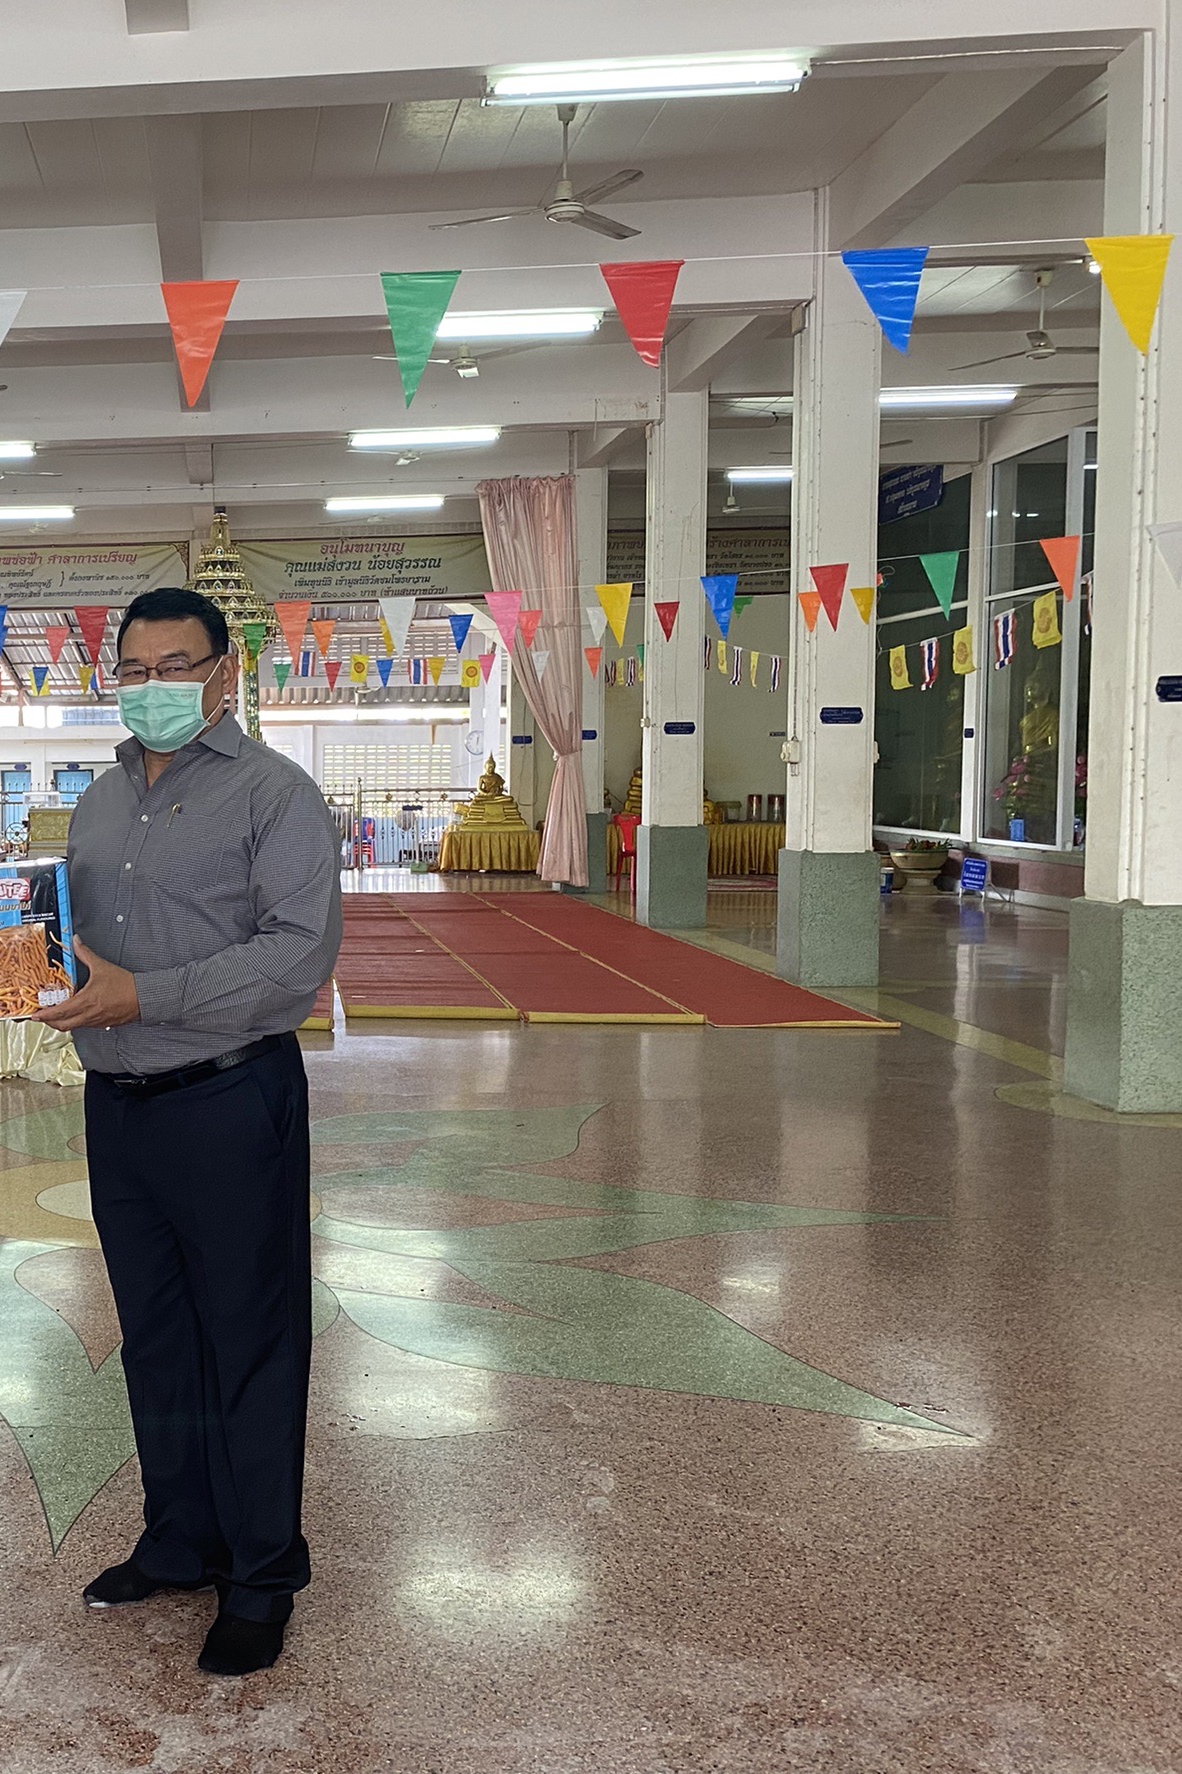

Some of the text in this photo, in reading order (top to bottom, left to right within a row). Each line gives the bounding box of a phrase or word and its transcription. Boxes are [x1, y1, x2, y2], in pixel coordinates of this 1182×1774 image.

[47, 550, 138, 566] ศาลาการเปรียญ
[320, 538, 405, 558] อนุโมทนาบุญ
[284, 554, 442, 578] คุณแม่สงวน น้อยสุวรรณ
